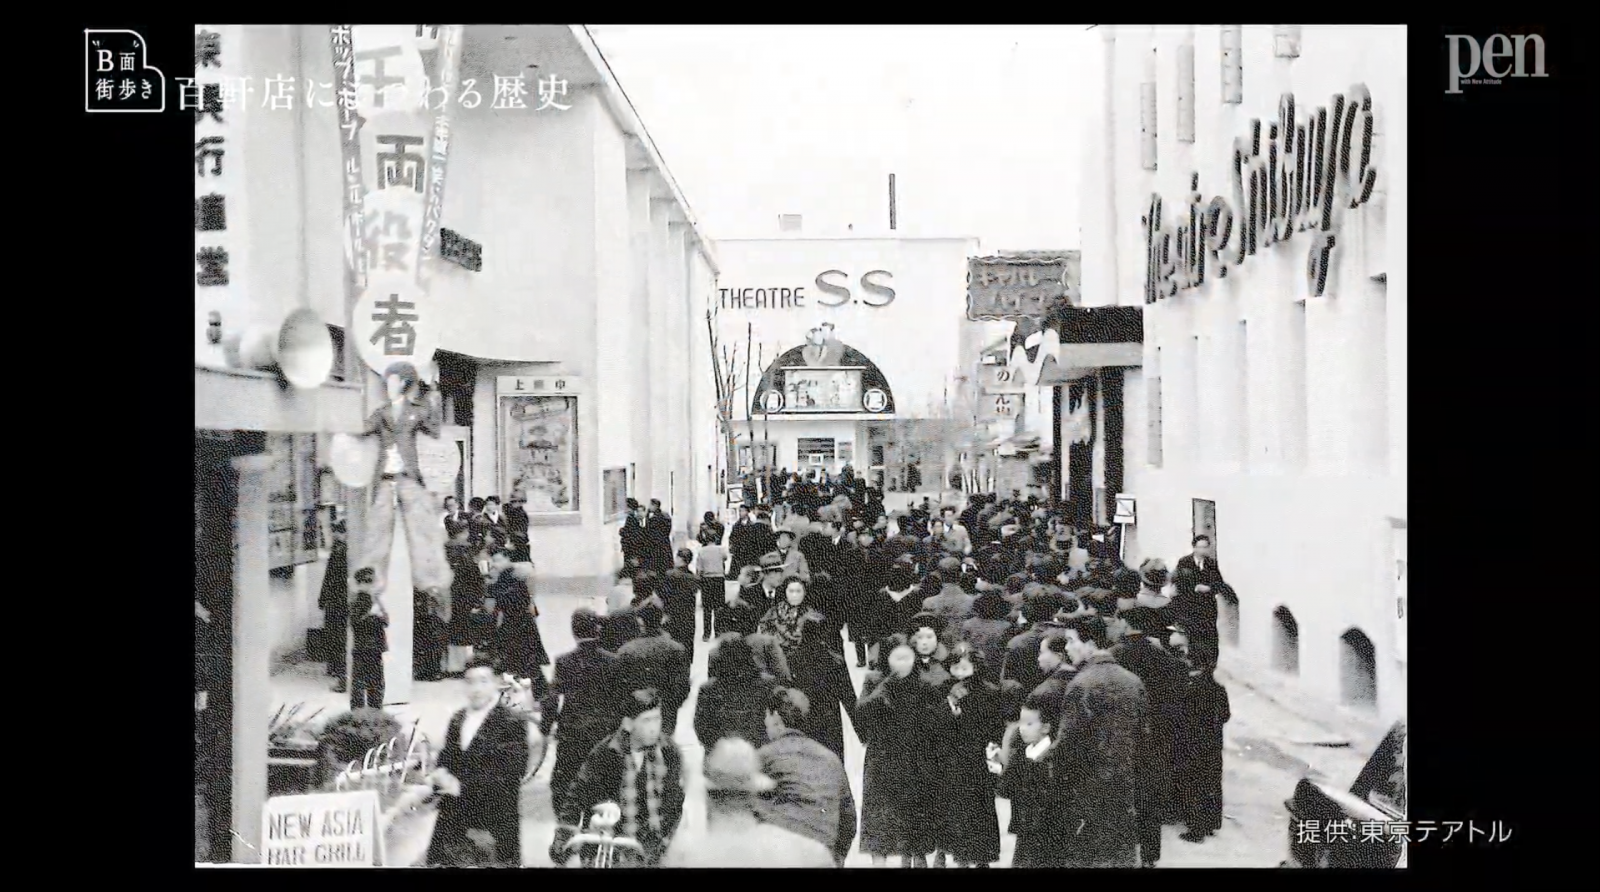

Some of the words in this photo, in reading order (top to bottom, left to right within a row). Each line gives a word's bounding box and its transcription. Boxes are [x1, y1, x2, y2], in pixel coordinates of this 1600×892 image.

[718, 286, 805, 310] THEATRE
[815, 269, 896, 308] S.S
[269, 812, 312, 841] NEW
[321, 808, 364, 838] ASIA
